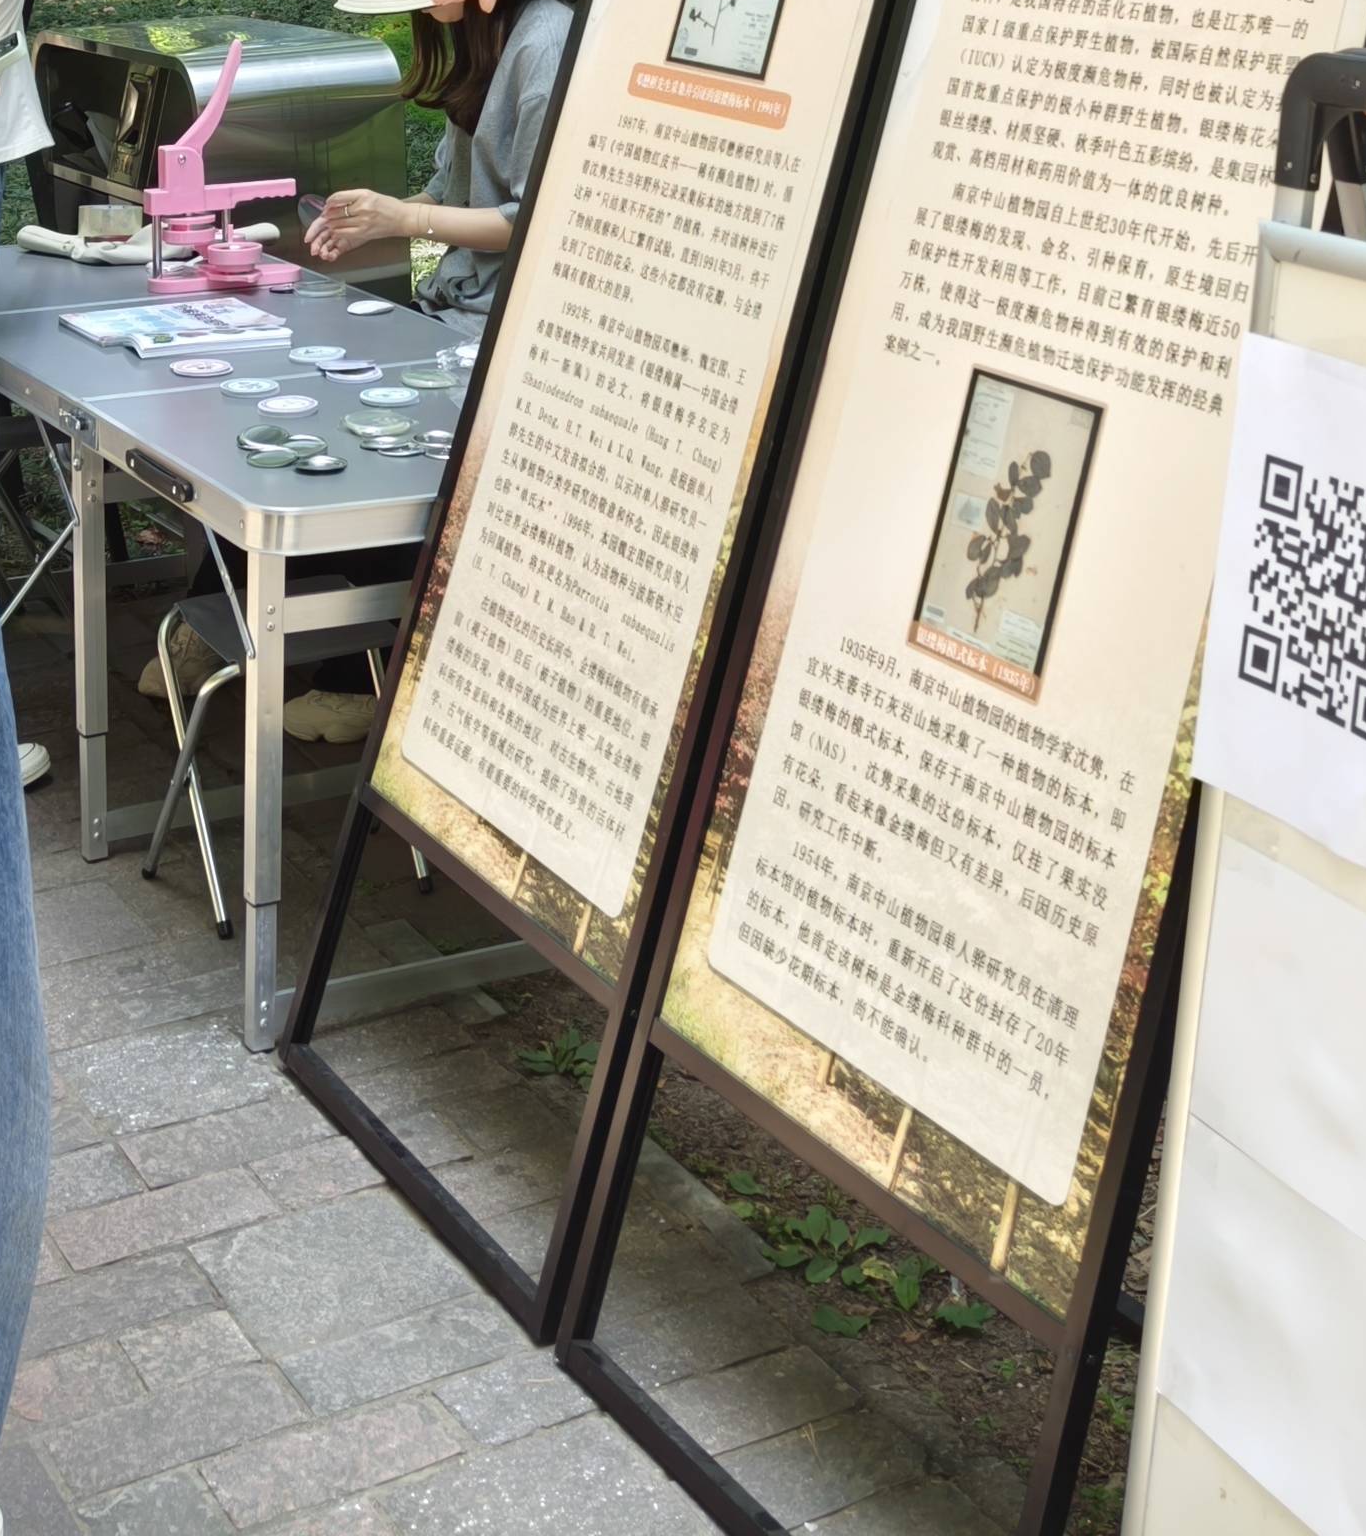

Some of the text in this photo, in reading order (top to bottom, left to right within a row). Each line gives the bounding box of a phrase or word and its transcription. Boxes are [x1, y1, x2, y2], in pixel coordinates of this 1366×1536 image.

[884, 333, 940, 366] 案例之一。
[772, 785, 882, 863] 因，研究工作中断。
